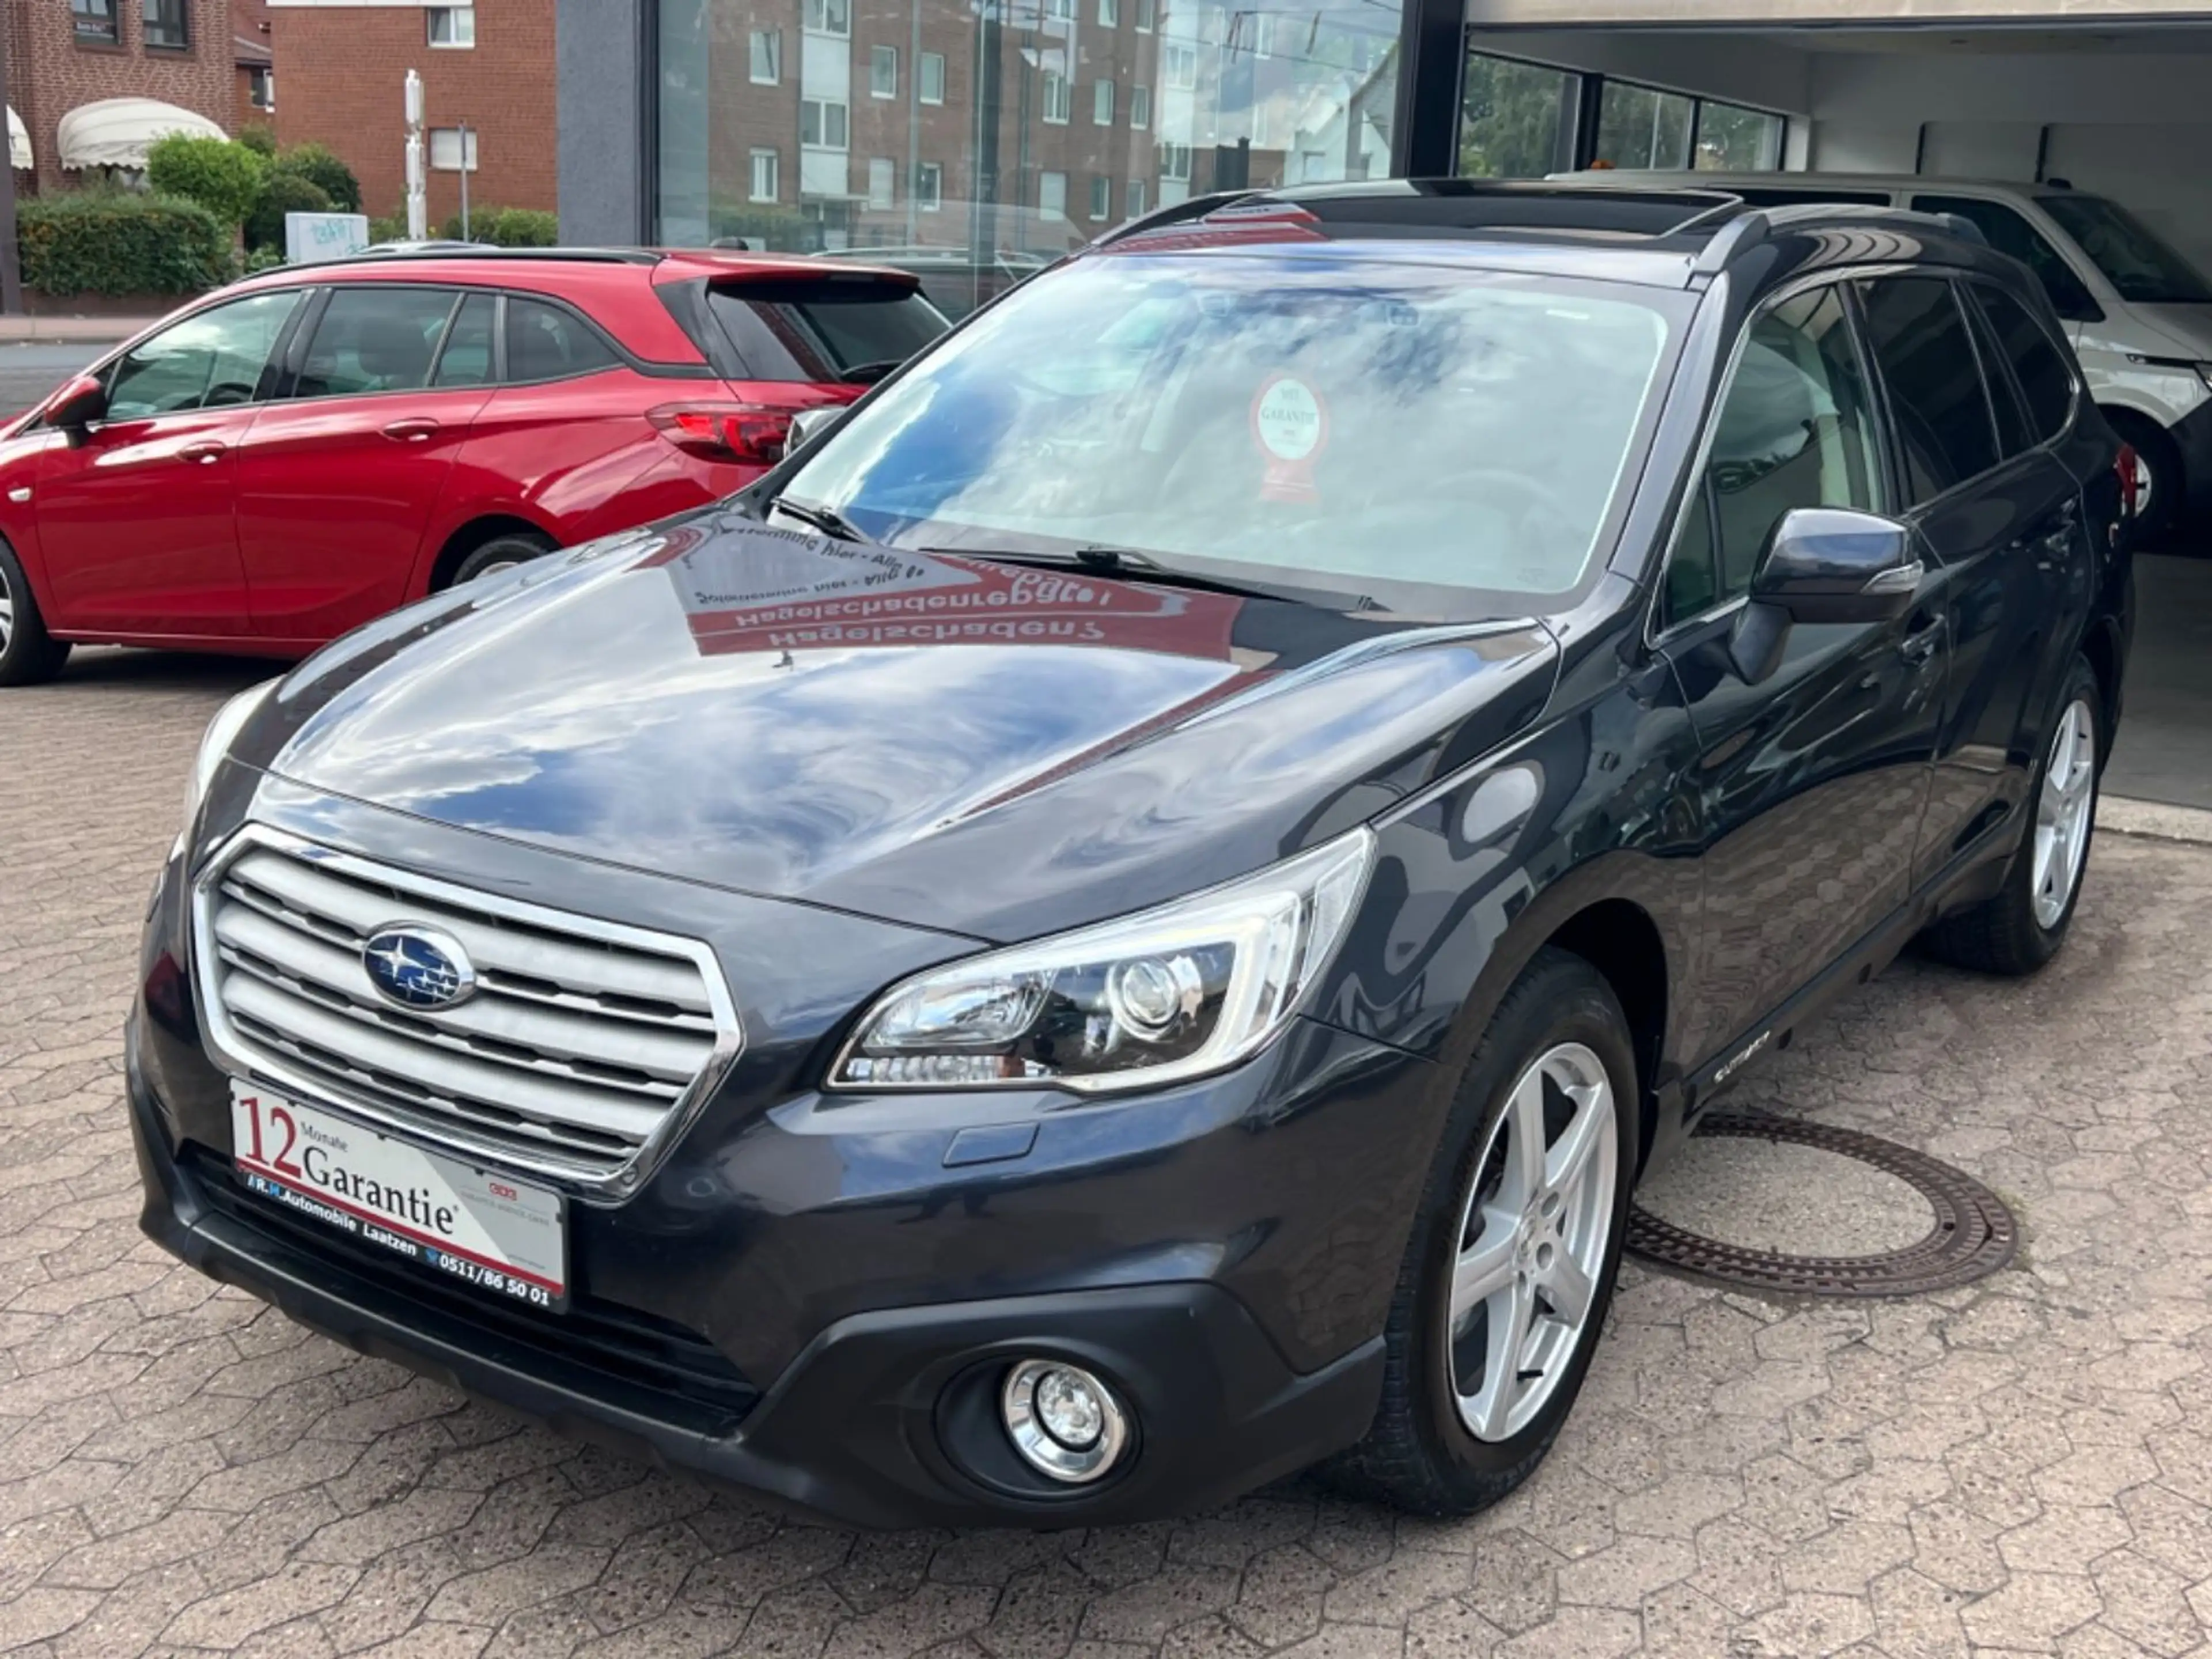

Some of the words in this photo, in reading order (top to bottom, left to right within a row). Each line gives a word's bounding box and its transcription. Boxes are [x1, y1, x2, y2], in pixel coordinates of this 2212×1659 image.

[239, 1096, 302, 1180] 12
[302, 1145, 455, 1236] Garantie
[362, 1222, 418, 1256] Laatzen
[439, 1253, 504, 1290] 0511/86
[506, 1277, 528, 1298] 50
[530, 1287, 550, 1307] 01
